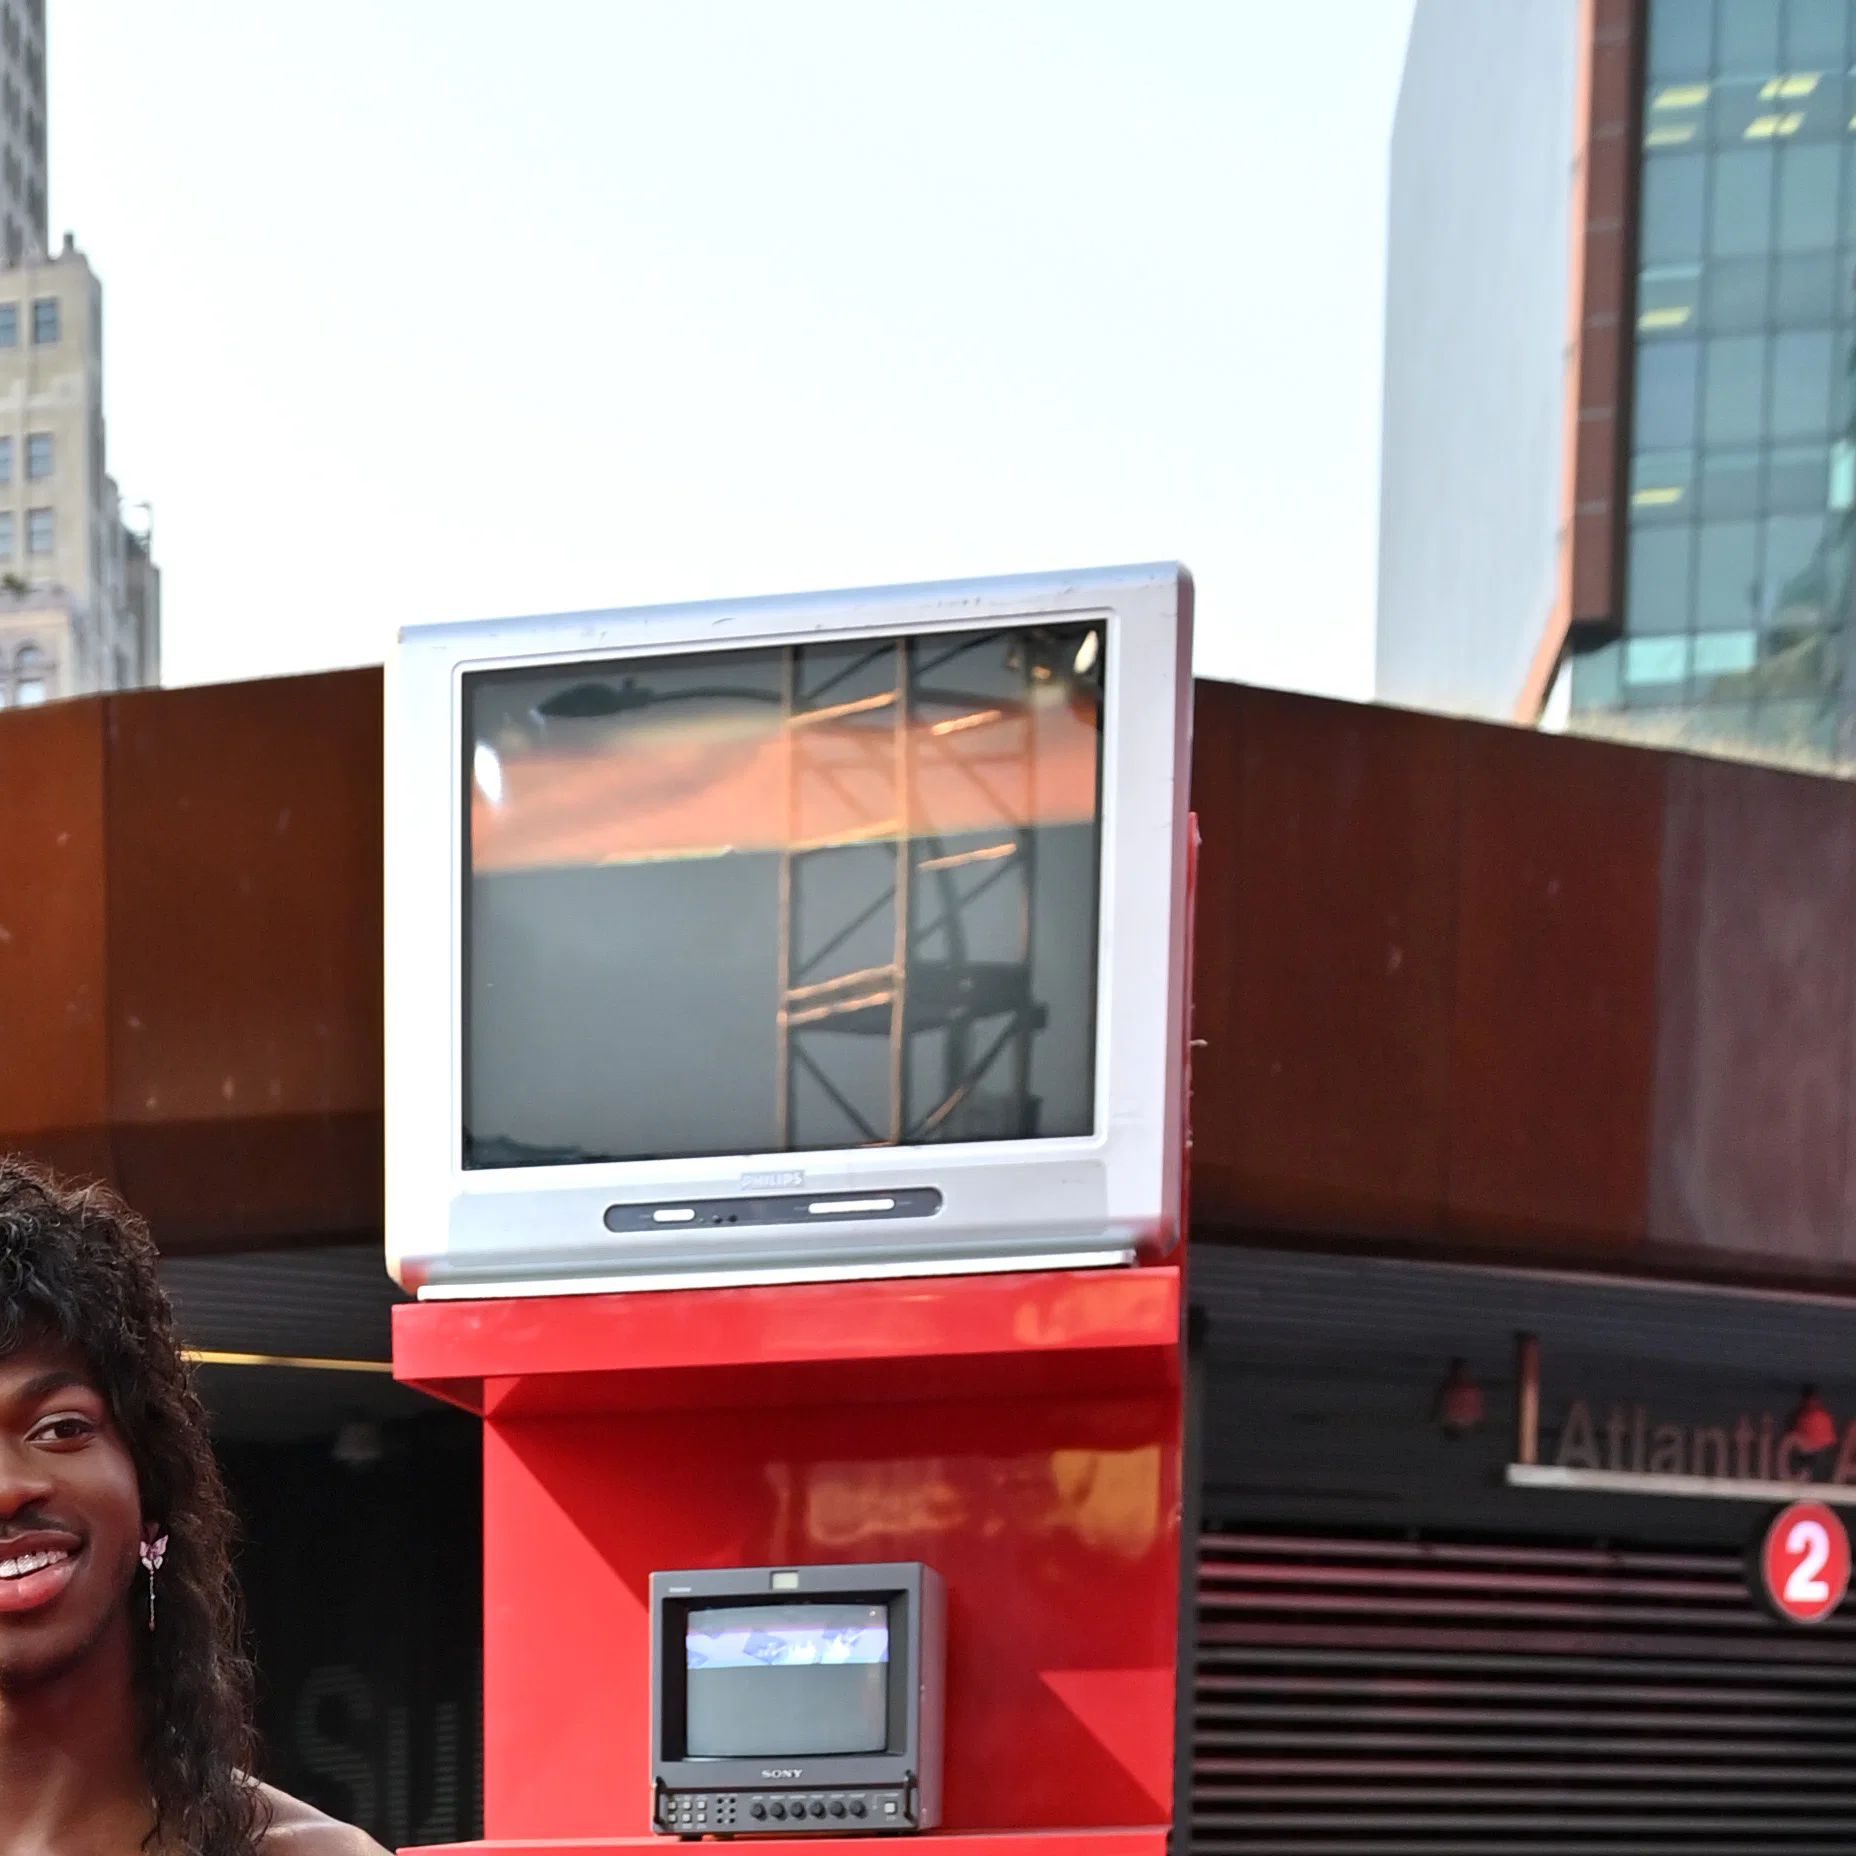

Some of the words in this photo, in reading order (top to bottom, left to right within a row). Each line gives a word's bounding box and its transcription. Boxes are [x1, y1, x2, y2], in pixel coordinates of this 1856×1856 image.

[741, 1172, 803, 1188] PHILIPS
[1555, 1397, 1813, 1483] Atlantic
[1783, 1519, 1830, 1602] 2
[760, 1768, 804, 1779] SONY
